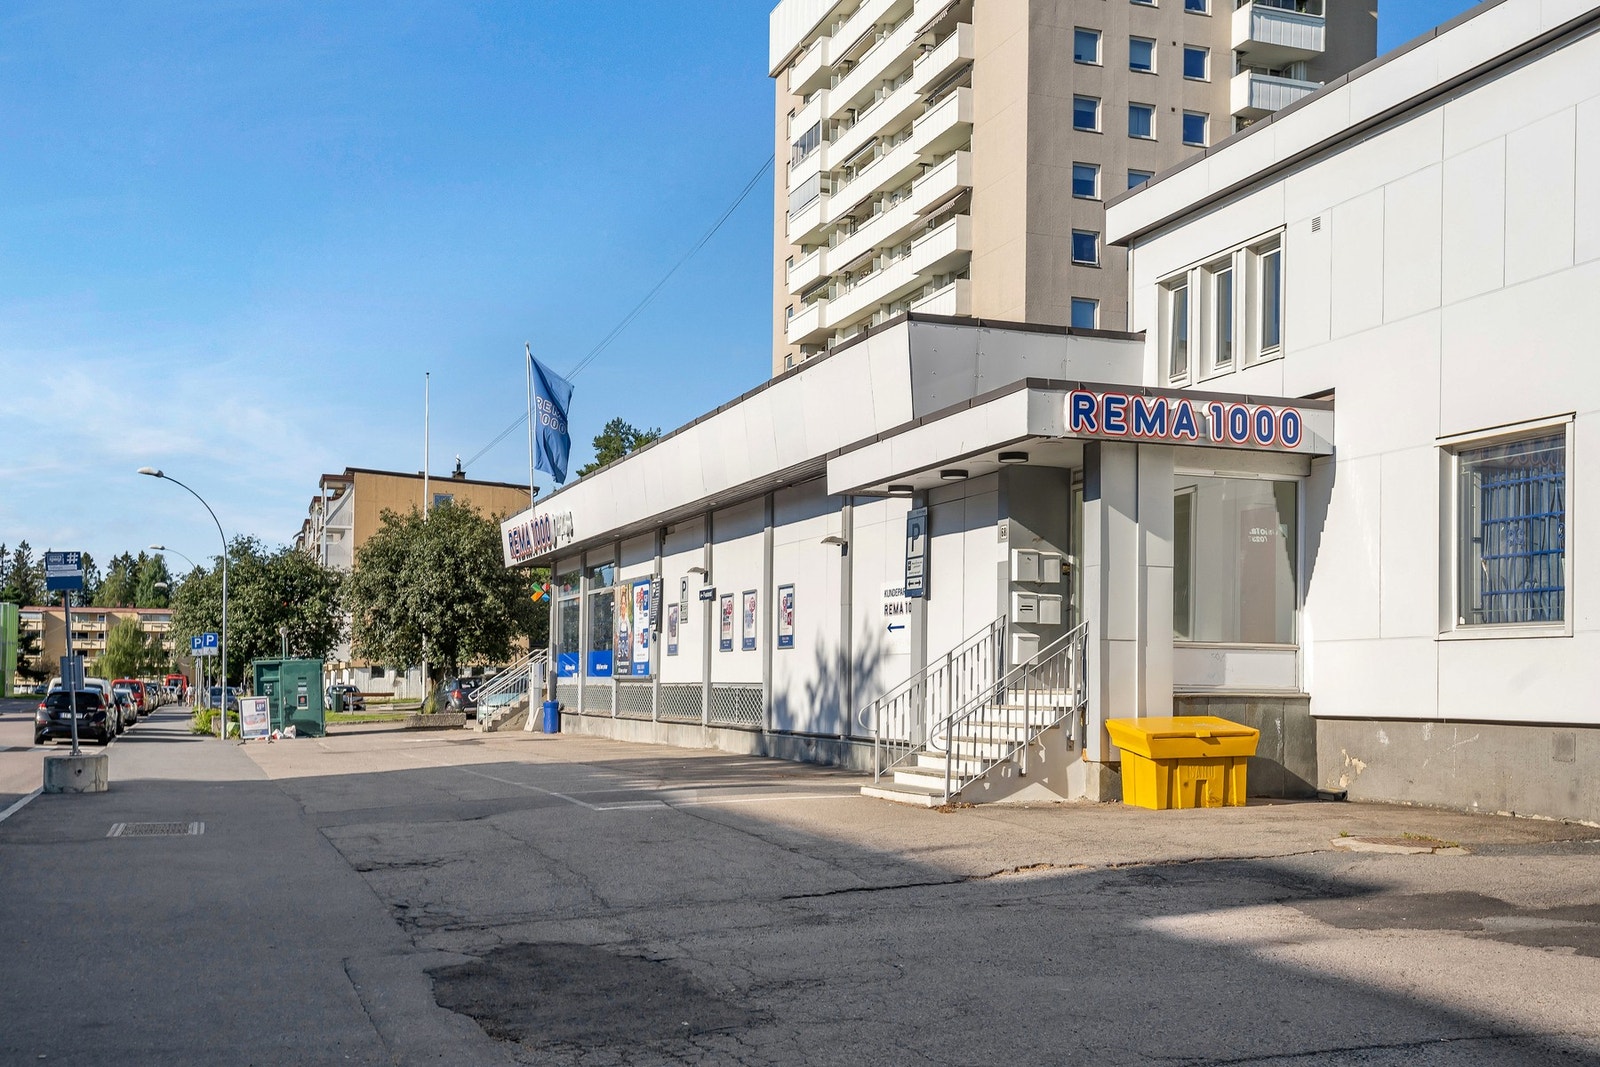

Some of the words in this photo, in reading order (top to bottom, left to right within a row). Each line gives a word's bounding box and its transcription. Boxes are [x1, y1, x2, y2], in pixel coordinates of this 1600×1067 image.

[1069, 389, 1199, 441] REMA
[1208, 400, 1303, 449] 1000
[508, 521, 533, 559] REMA
[530, 512, 553, 551] 1000
[911, 522, 920, 552] P
[681, 580, 687, 599] P
[884, 602, 903, 616] REMA
[194, 638, 201, 648] P
[206, 635, 214, 646] P
